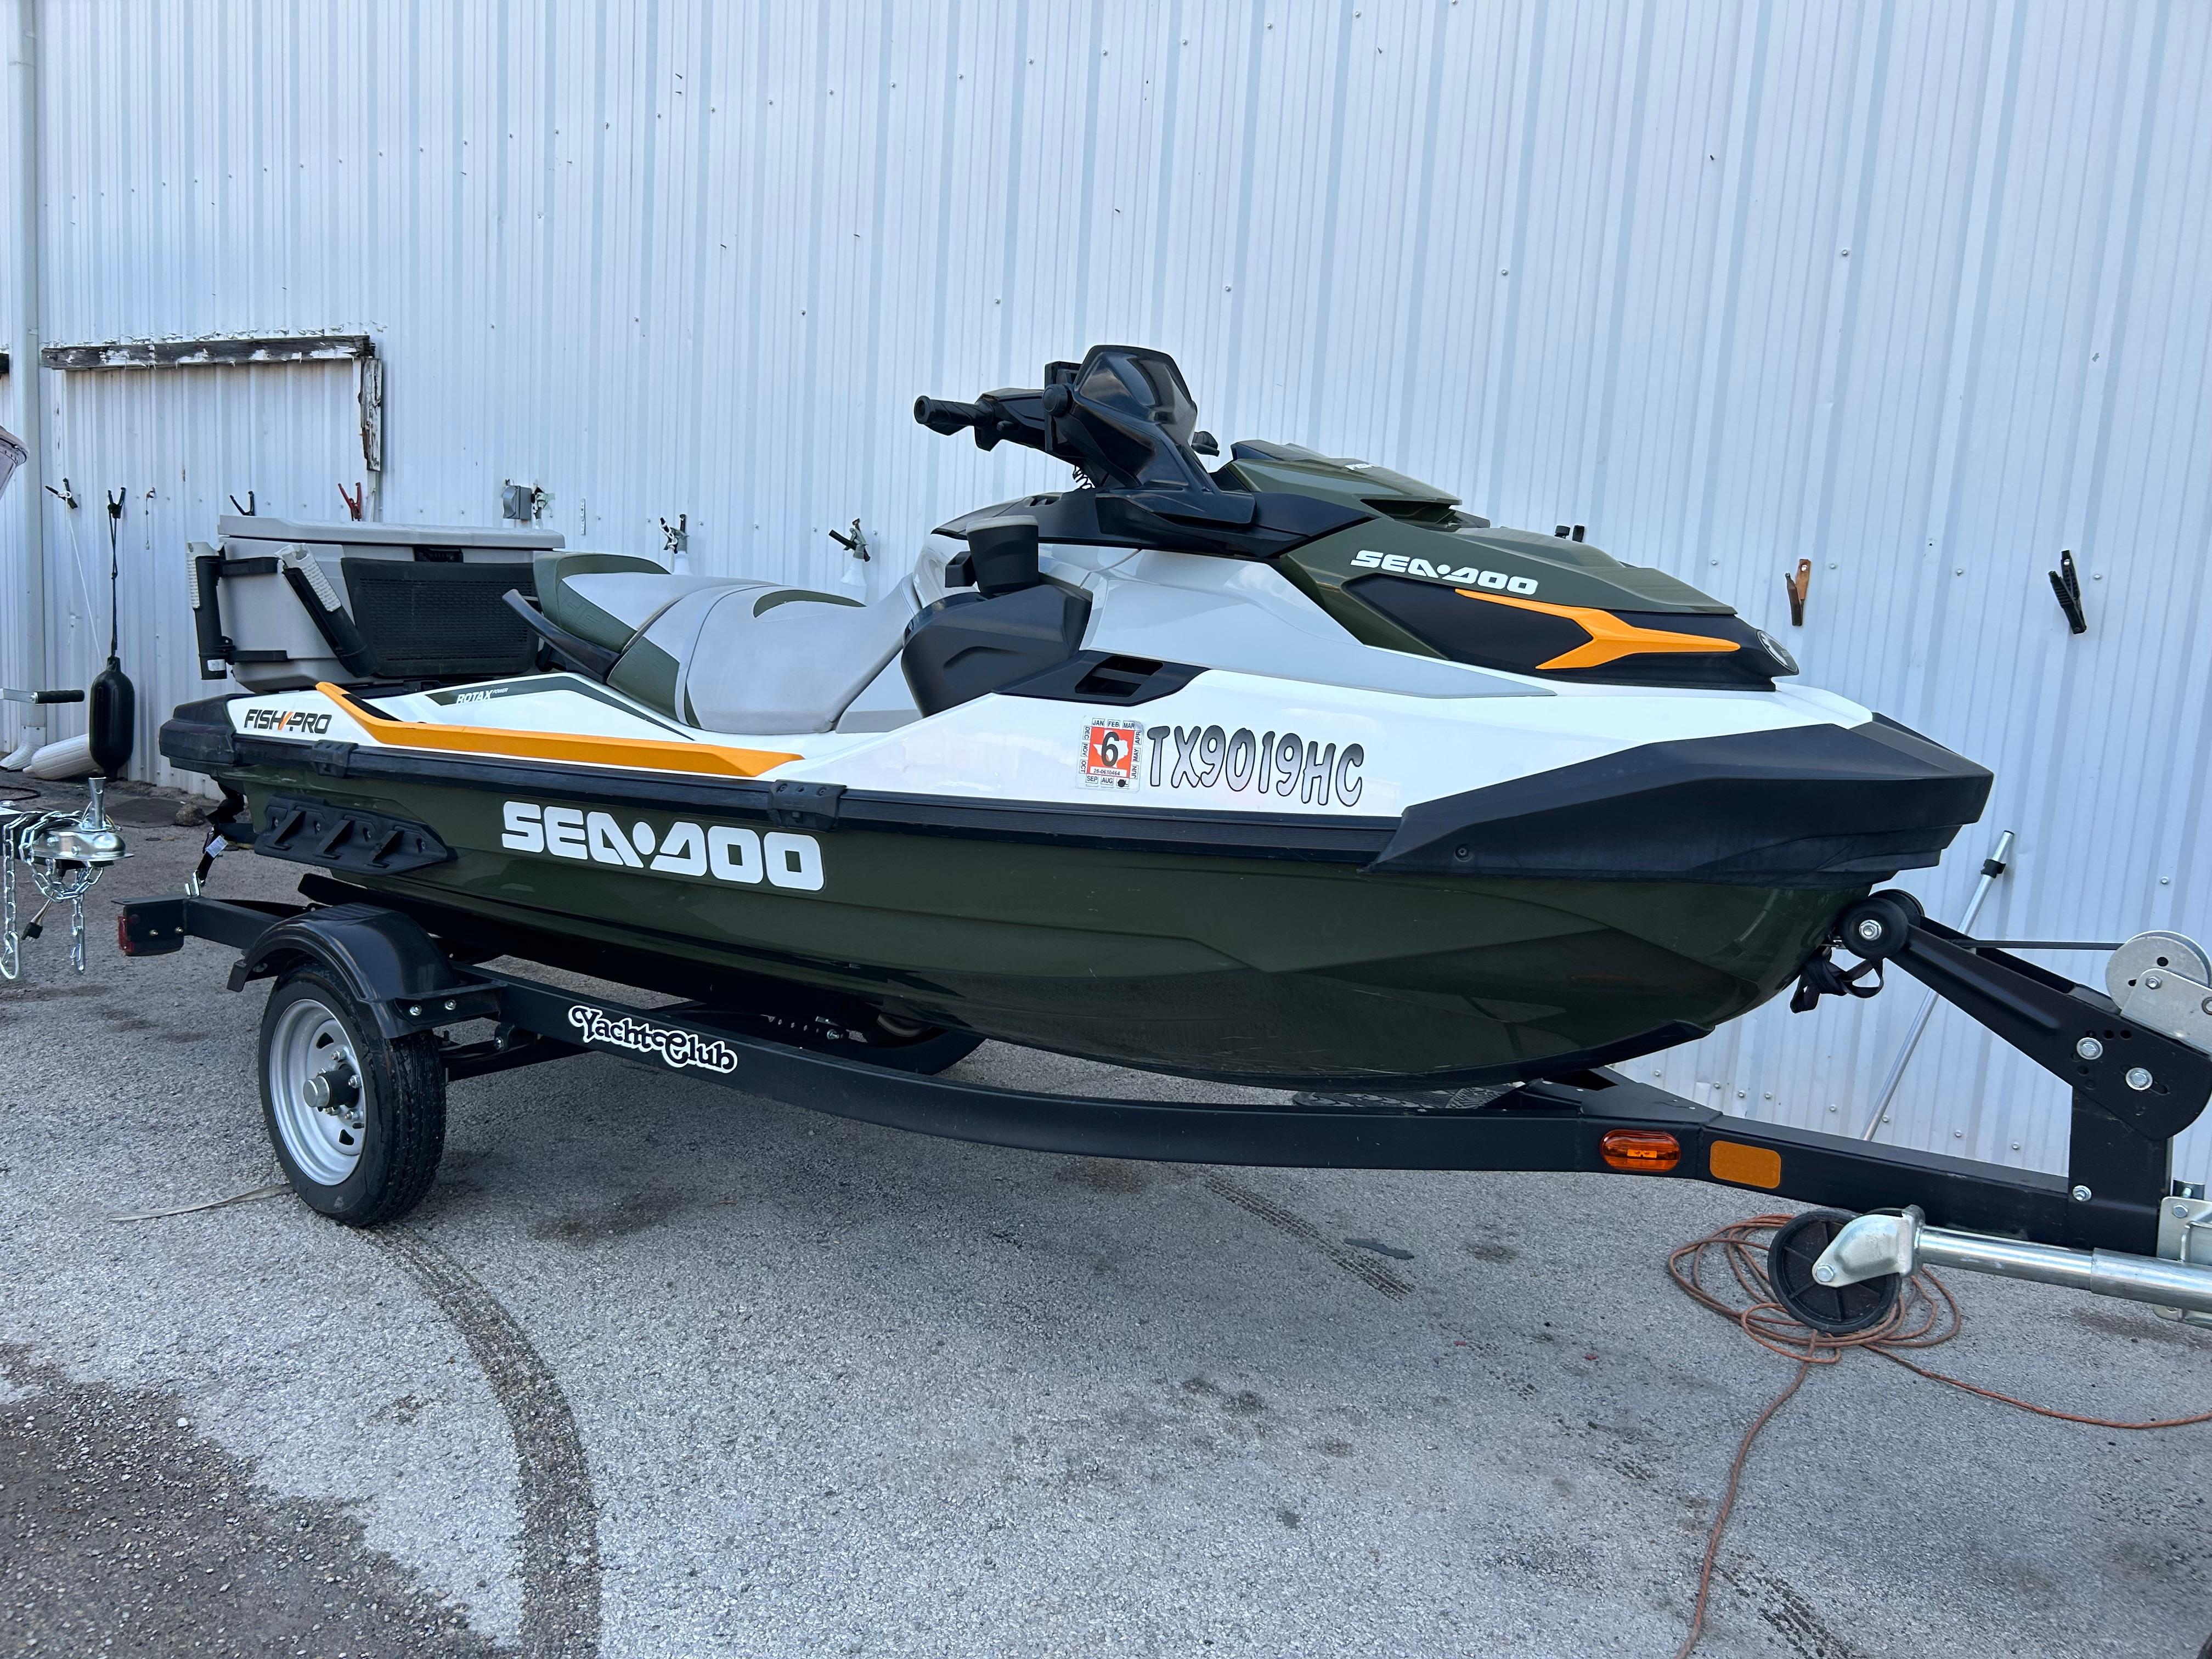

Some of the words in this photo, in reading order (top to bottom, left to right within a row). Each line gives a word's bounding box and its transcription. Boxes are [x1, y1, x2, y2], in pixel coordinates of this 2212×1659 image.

[456, 690, 493, 704] ROTAX
[1101, 731, 1119, 767] 6
[1147, 725, 1364, 806] TX9019HC
